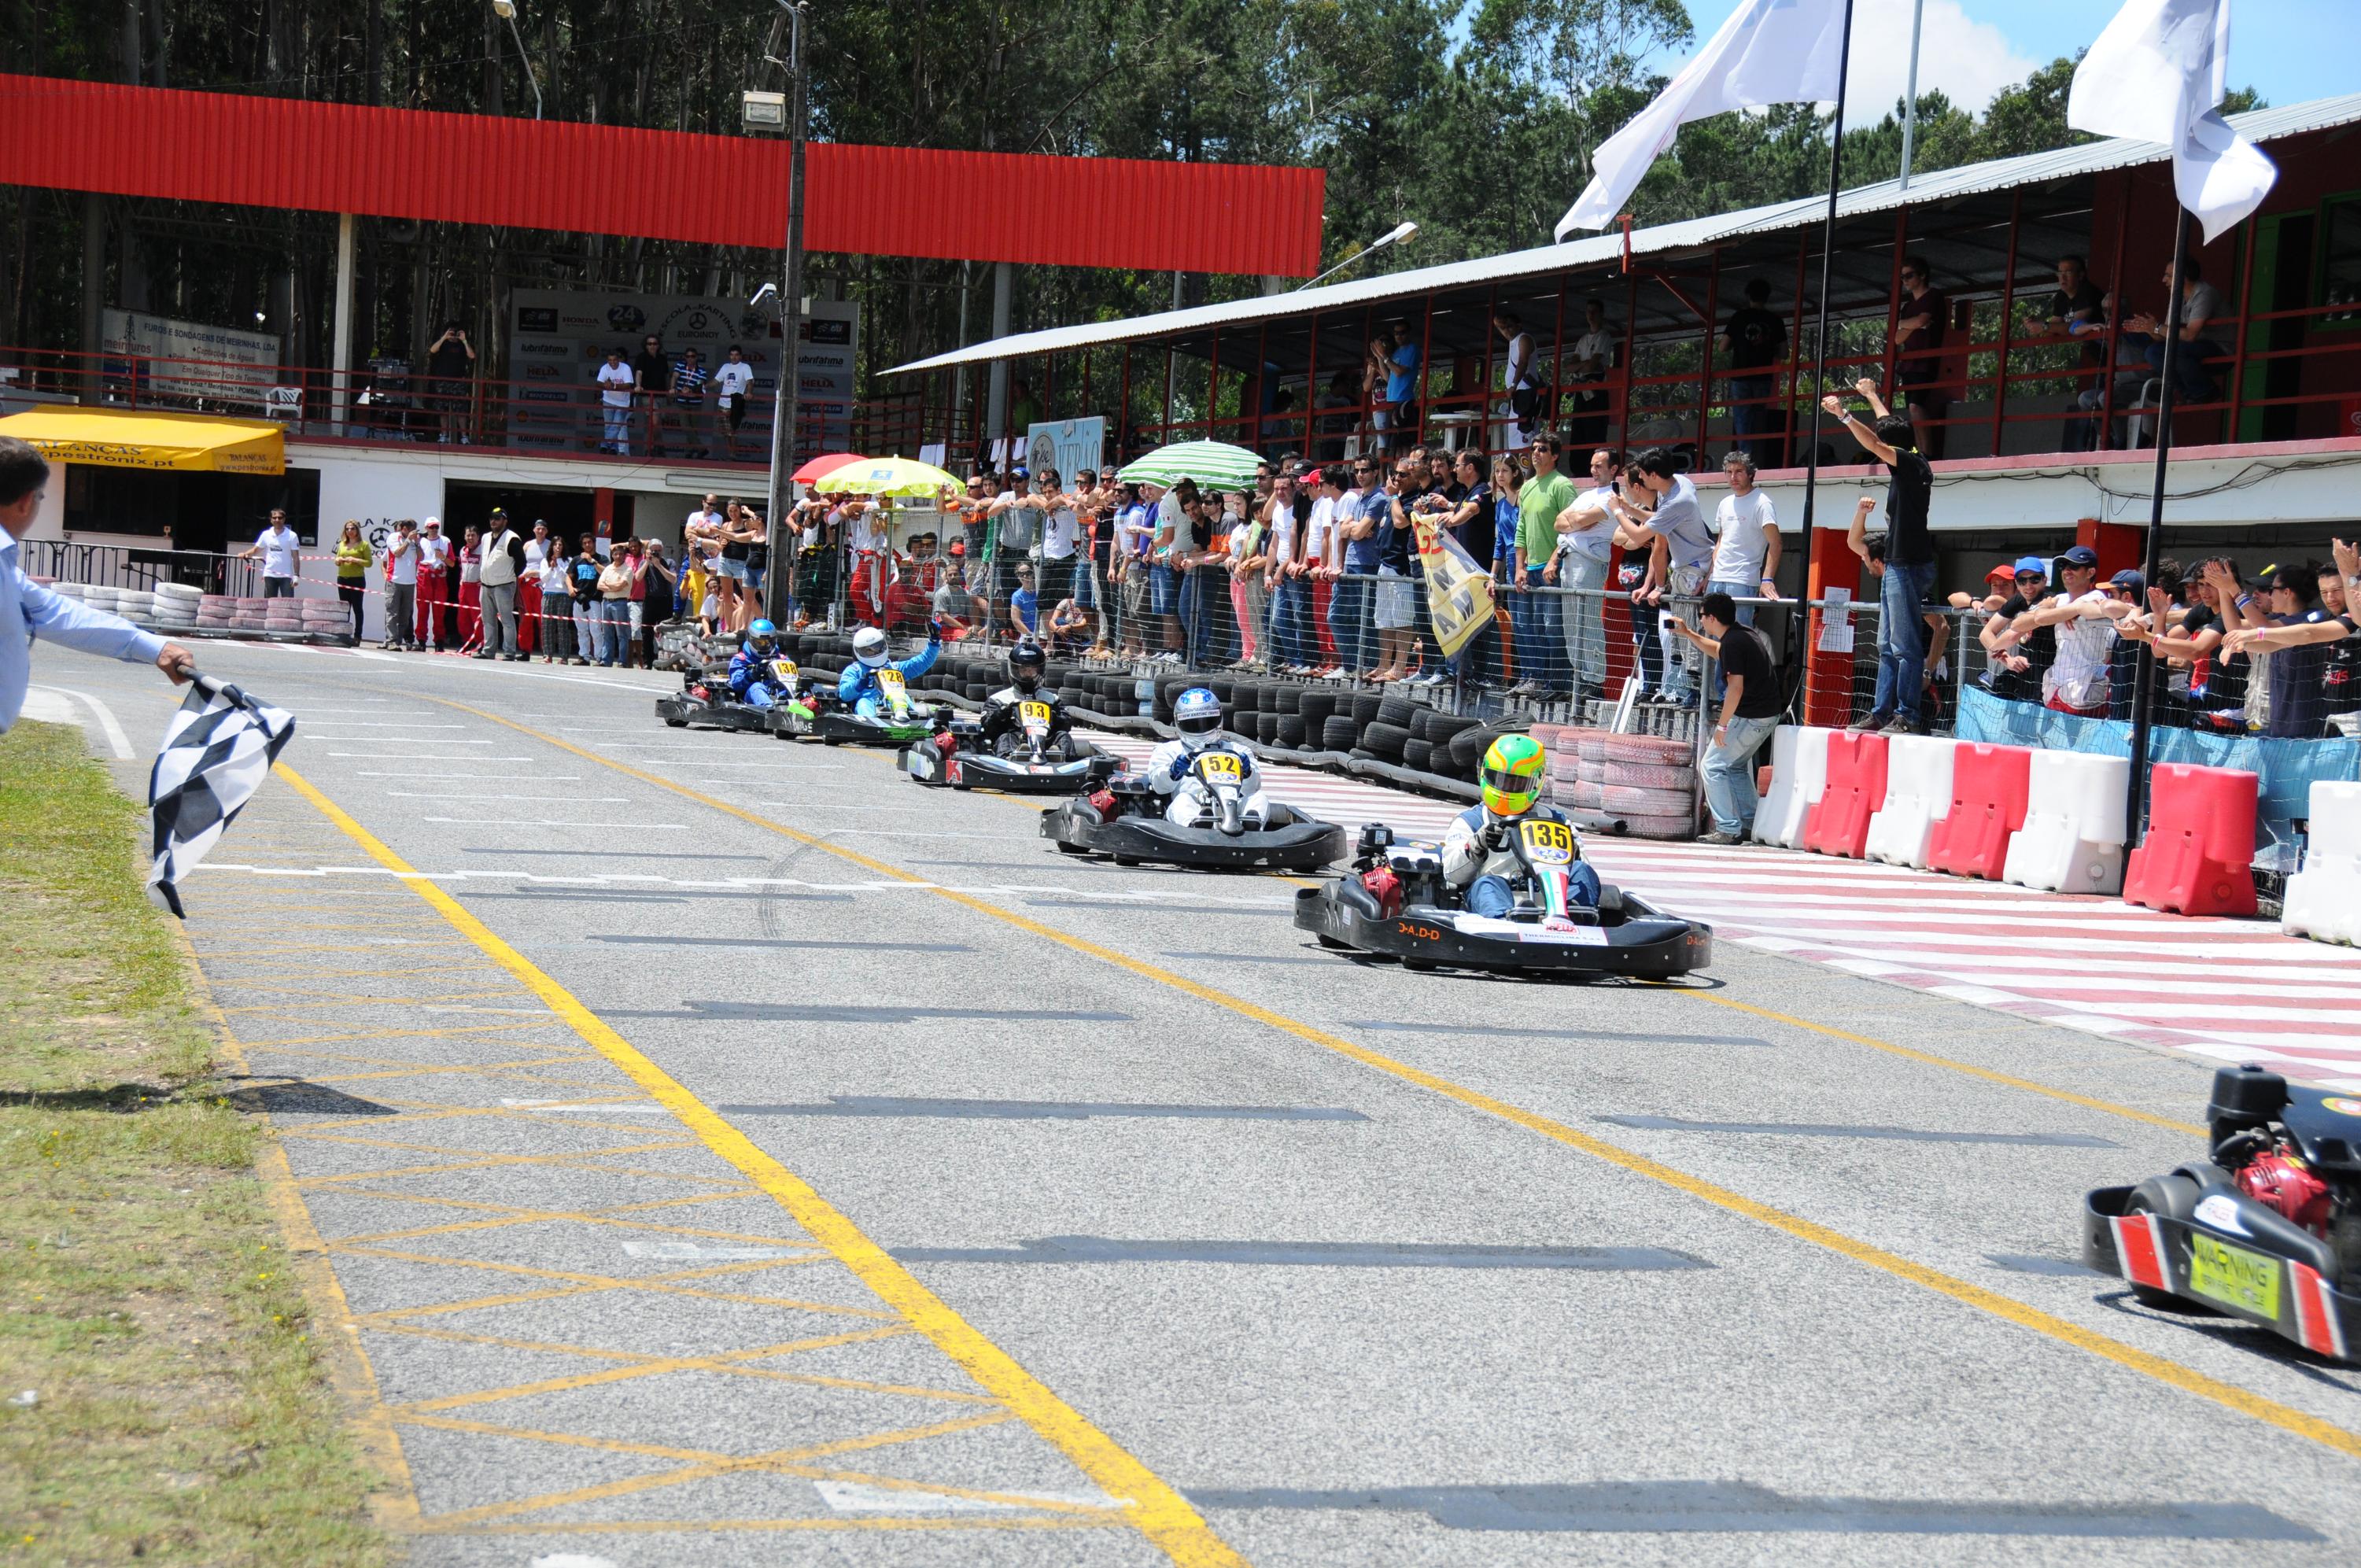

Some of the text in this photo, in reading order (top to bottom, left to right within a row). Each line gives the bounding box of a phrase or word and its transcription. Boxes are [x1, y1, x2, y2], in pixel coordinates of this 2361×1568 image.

[144, 323, 168, 334] FUROS
[168, 327, 173, 336] E
[174, 329, 215, 343] SONDAGENS
[216, 334, 226, 345] DE
[33, 440, 142, 456] ALANÇAS
[777, 663, 798, 675] 138
[1025, 703, 1045, 718] 93
[1208, 756, 1236, 773] 52
[1523, 824, 1568, 850] 135
